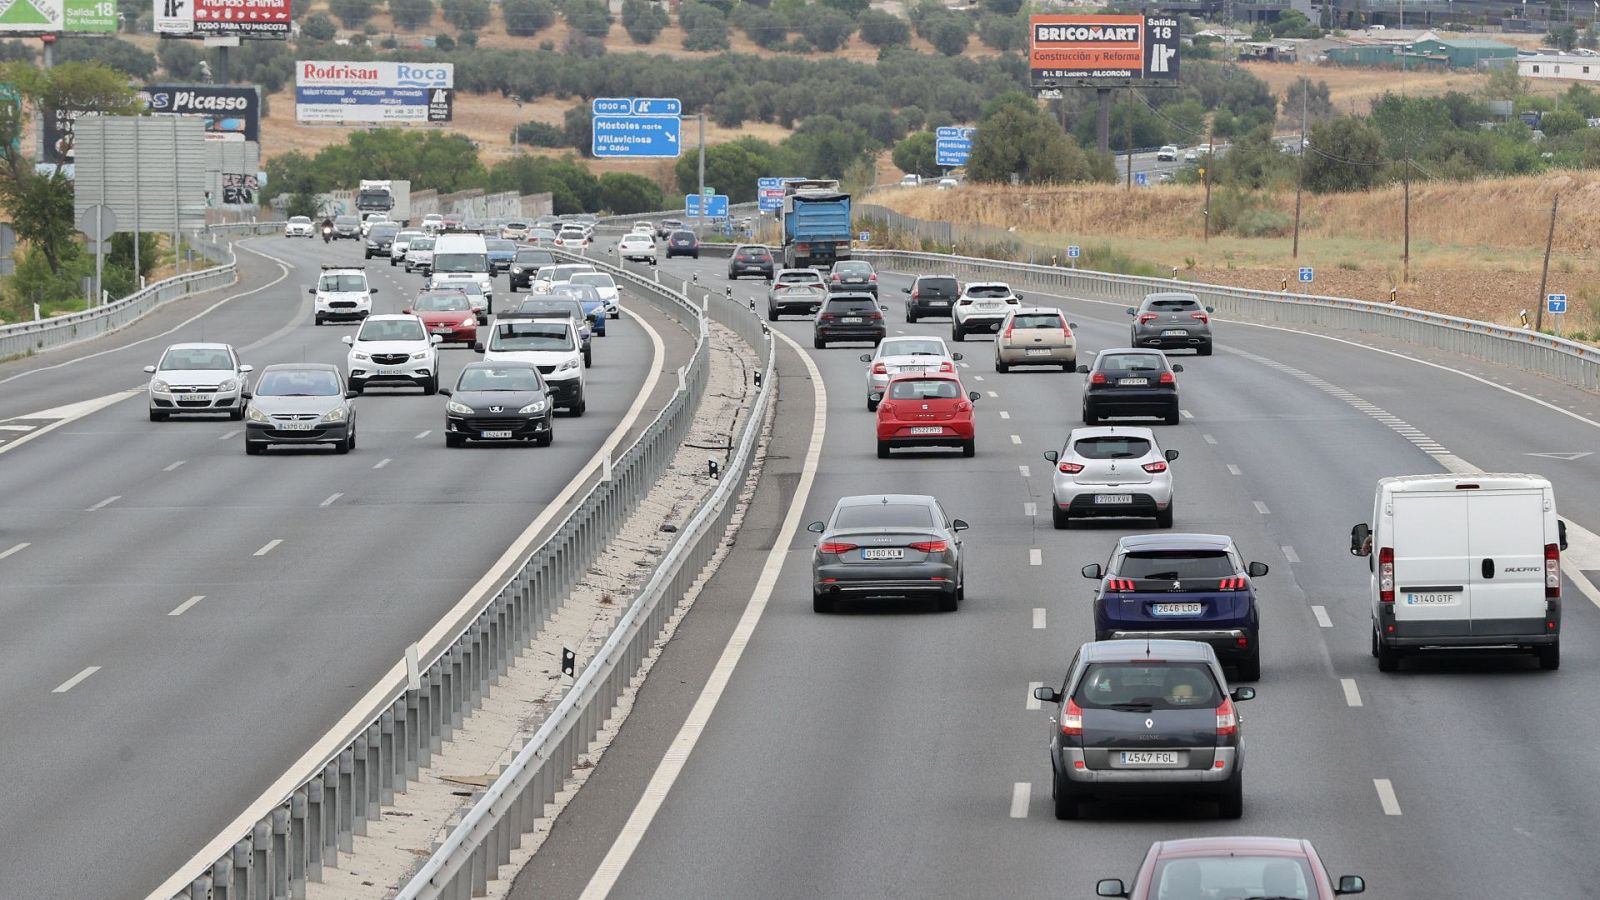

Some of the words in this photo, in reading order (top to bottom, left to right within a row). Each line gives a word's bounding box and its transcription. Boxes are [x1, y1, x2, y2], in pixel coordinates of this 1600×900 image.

[67, 8, 95, 17] Salida
[95, 2, 113, 17] 18
[196, 22, 220, 30] TODO
[220, 22, 240, 30] PARA
[252, 23, 288, 31] MASCOTA
[1148, 18, 1177, 27] Salida
[1038, 27, 1136, 41] BRICOMART
[1152, 27, 1172, 39] 18
[1034, 51, 1091, 61] Construcción
[1094, 53, 1100, 62] y
[1103, 52, 1140, 61] Reforma
[303, 63, 378, 80] Rodrisan
[397, 64, 447, 80] Roca
[172, 91, 248, 111] Picasso
[597, 121, 640, 130] Móstoles
[597, 135, 652, 144] Villaviciosa
[1553, 302, 1560, 311] 7
[866, 549, 886, 557] 0160
[1413, 594, 1435, 603] 3140
[1437, 594, 1453, 602] GTF
[1158, 604, 1180, 612] 2646
[1128, 753, 1153, 763] 4547
[1156, 753, 1175, 762] FGL
